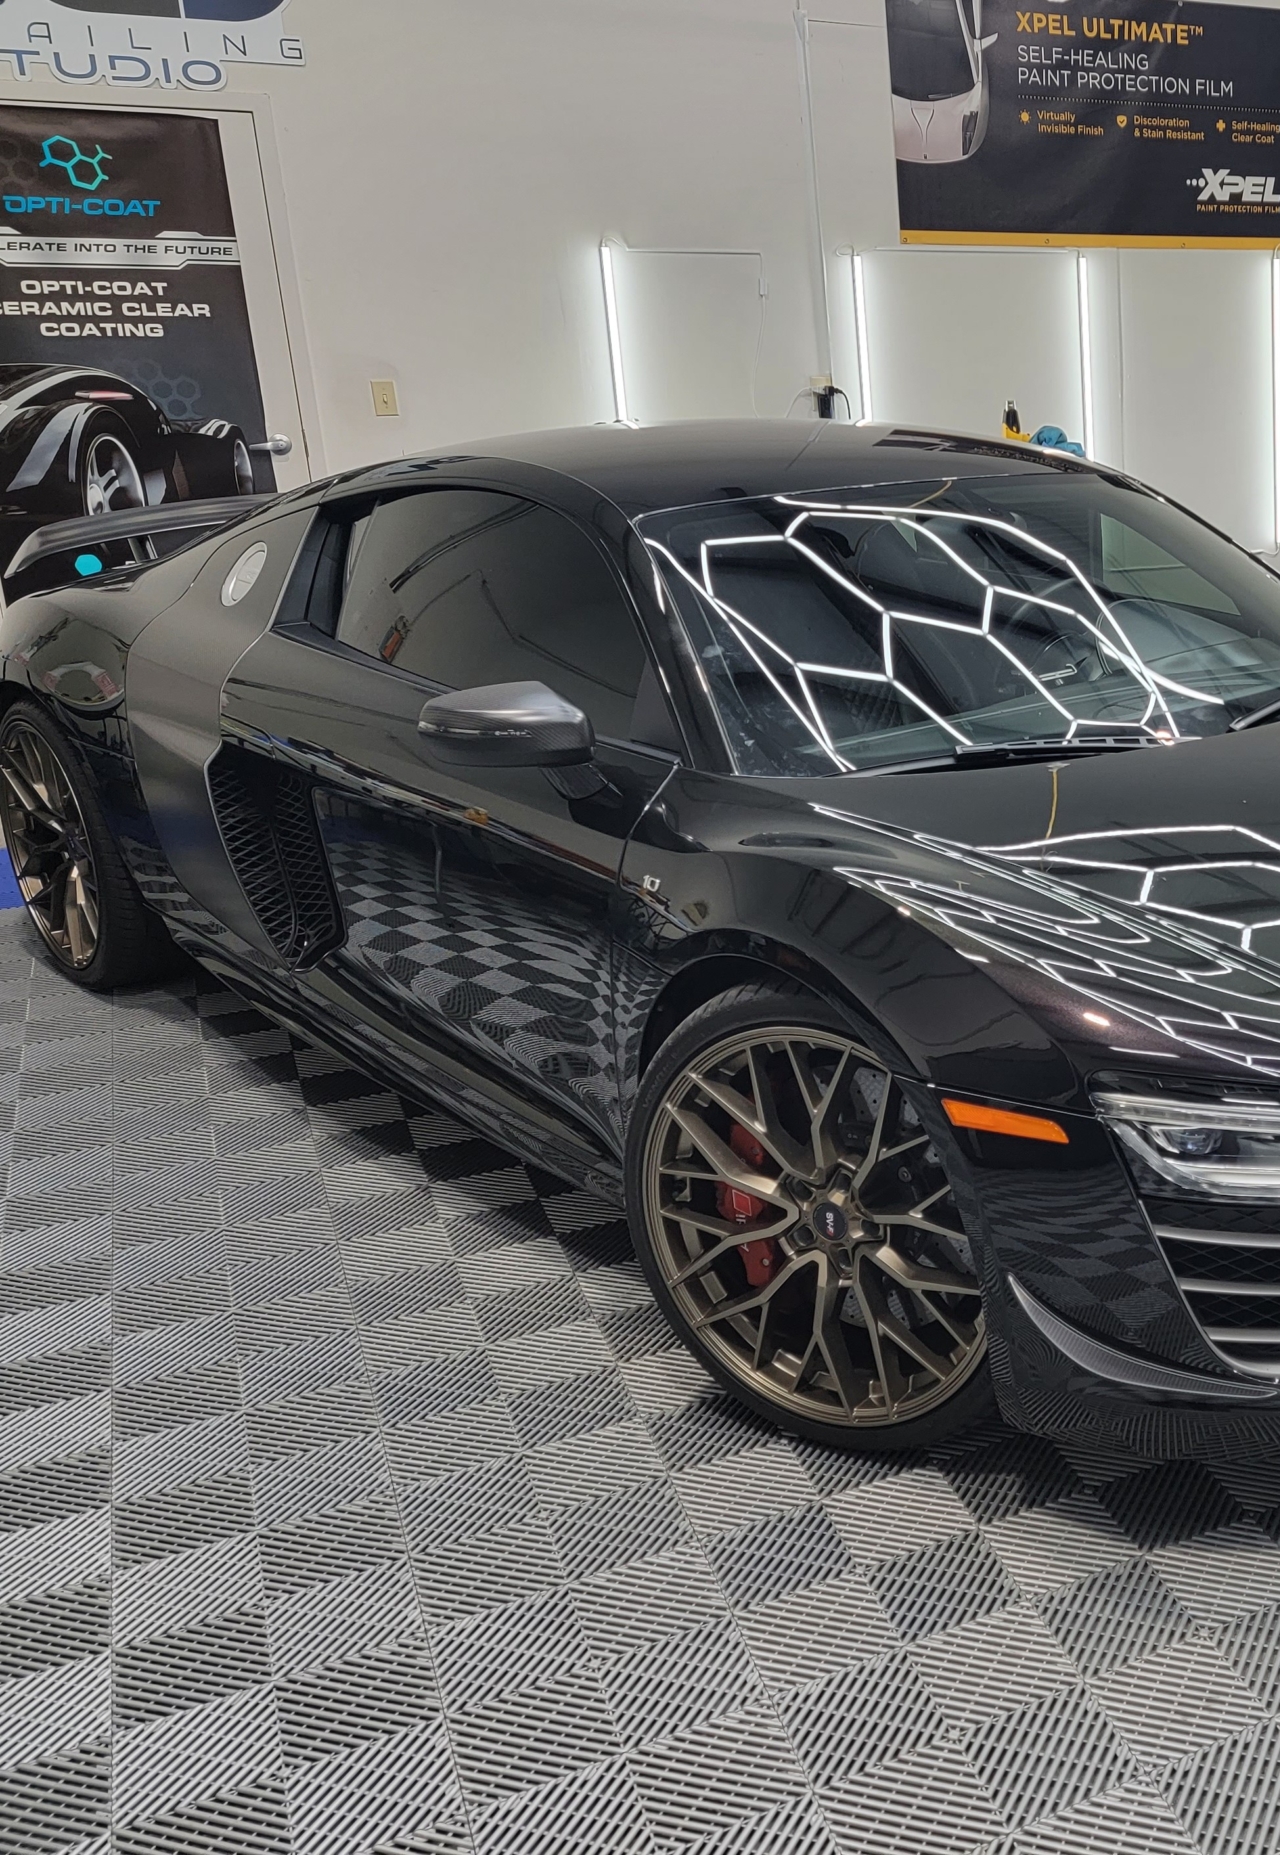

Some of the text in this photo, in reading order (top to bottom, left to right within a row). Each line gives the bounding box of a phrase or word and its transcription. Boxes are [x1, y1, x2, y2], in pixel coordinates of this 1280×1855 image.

[1016, 11, 1076, 37] XPEL
[1017, 45, 1150, 71] SELF-HEALING
[1018, 67, 1234, 98] PAINT PROTECTION FILM
[1037, 110, 1076, 124] Virtually
[1133, 116, 1190, 128] Discoloration
[1038, 123, 1104, 136] Invisible Finish
[1231, 120, 1280, 134] Self-Healing
[1133, 128, 1205, 142] & Stain Resistant
[1231, 133, 1275, 145] Clear Coat
[2, 195, 161, 217] OPTI-COAT
[1196, 204, 1280, 214] PAINT PROTECTION FILM
[74, 242, 117, 253] INTO
[122, 244, 158, 255] THE
[164, 246, 234, 257] FUTURE
[20, 279, 168, 296] OPTI-COAT
[0, 301, 212, 318] ERAMIC CLEAR
[39, 322, 165, 338] COATING
